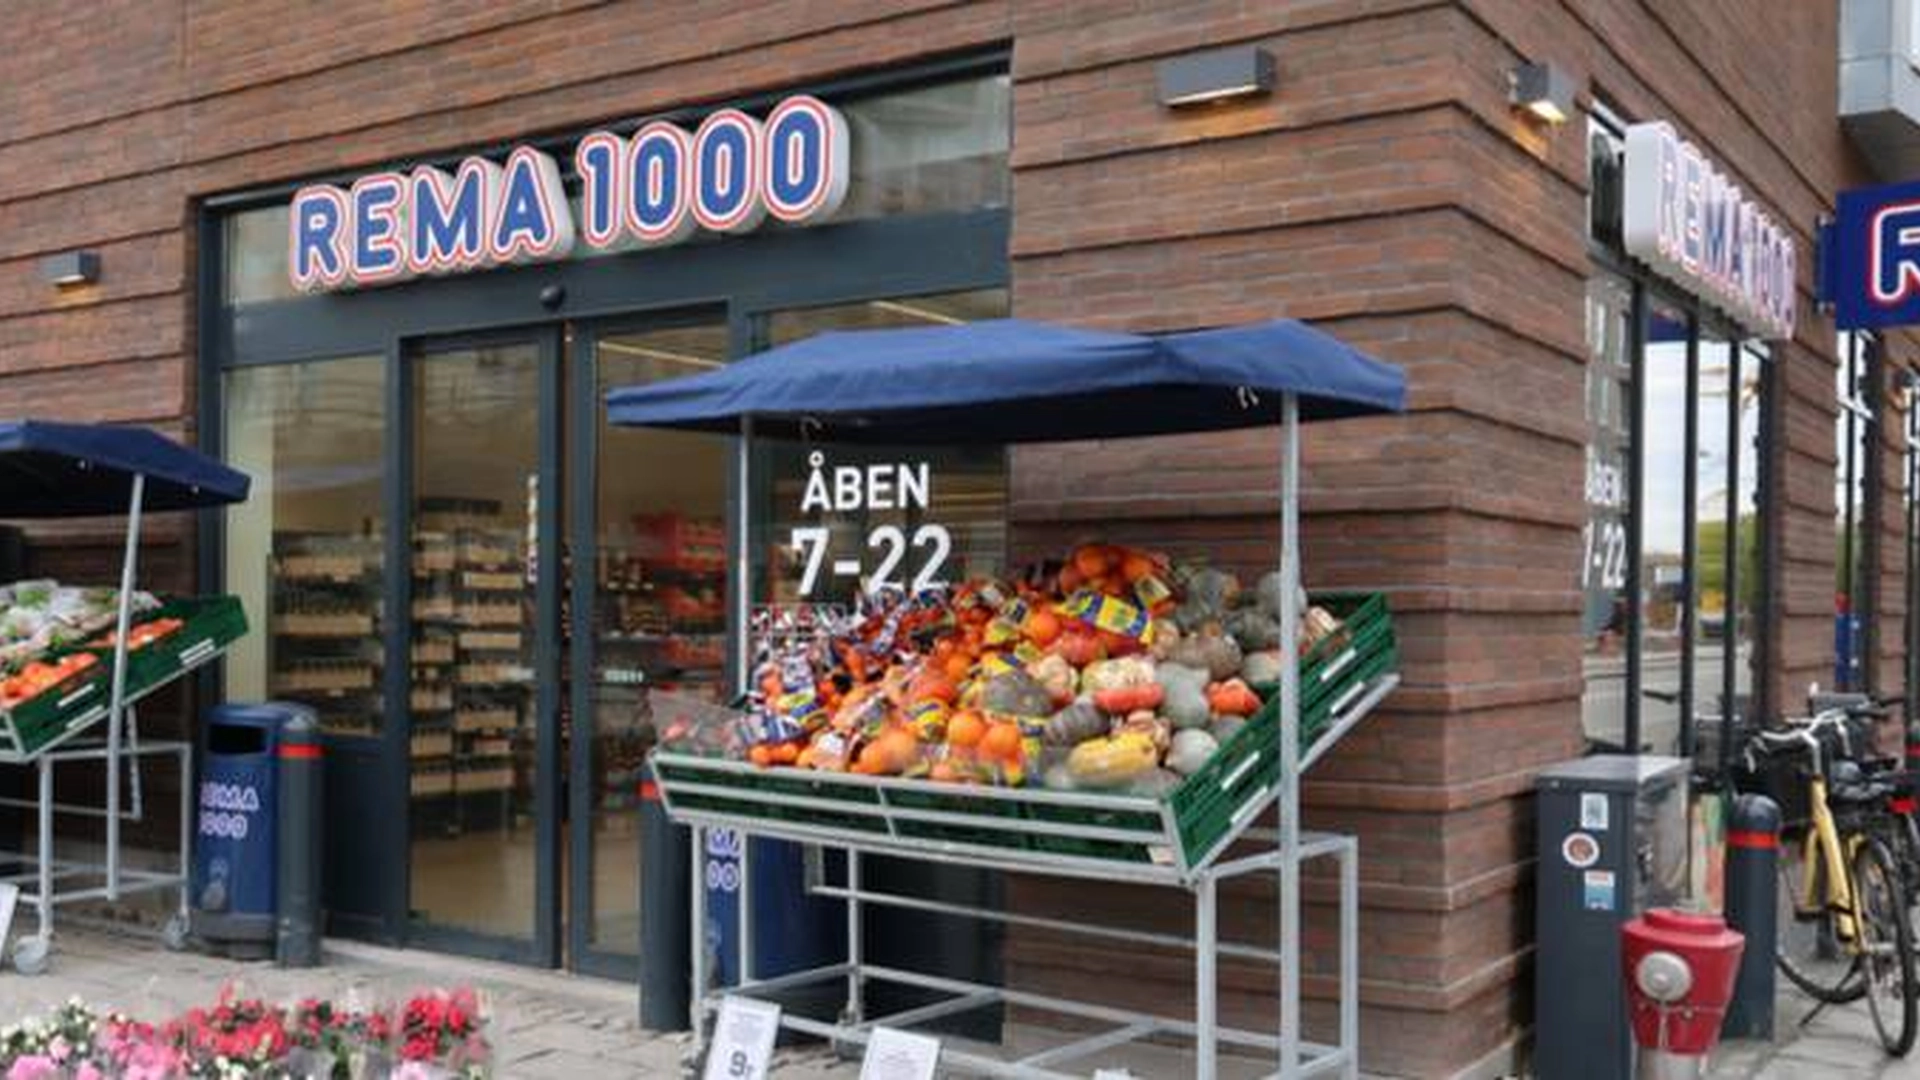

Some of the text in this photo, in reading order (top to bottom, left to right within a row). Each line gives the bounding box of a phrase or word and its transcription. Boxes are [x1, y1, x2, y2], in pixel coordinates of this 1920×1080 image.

[290, 95, 836, 288] REMA 1000
[1659, 122, 1744, 302] REMA
[800, 450, 930, 511] ÅBEN
[790, 524, 951, 597] 7-22
